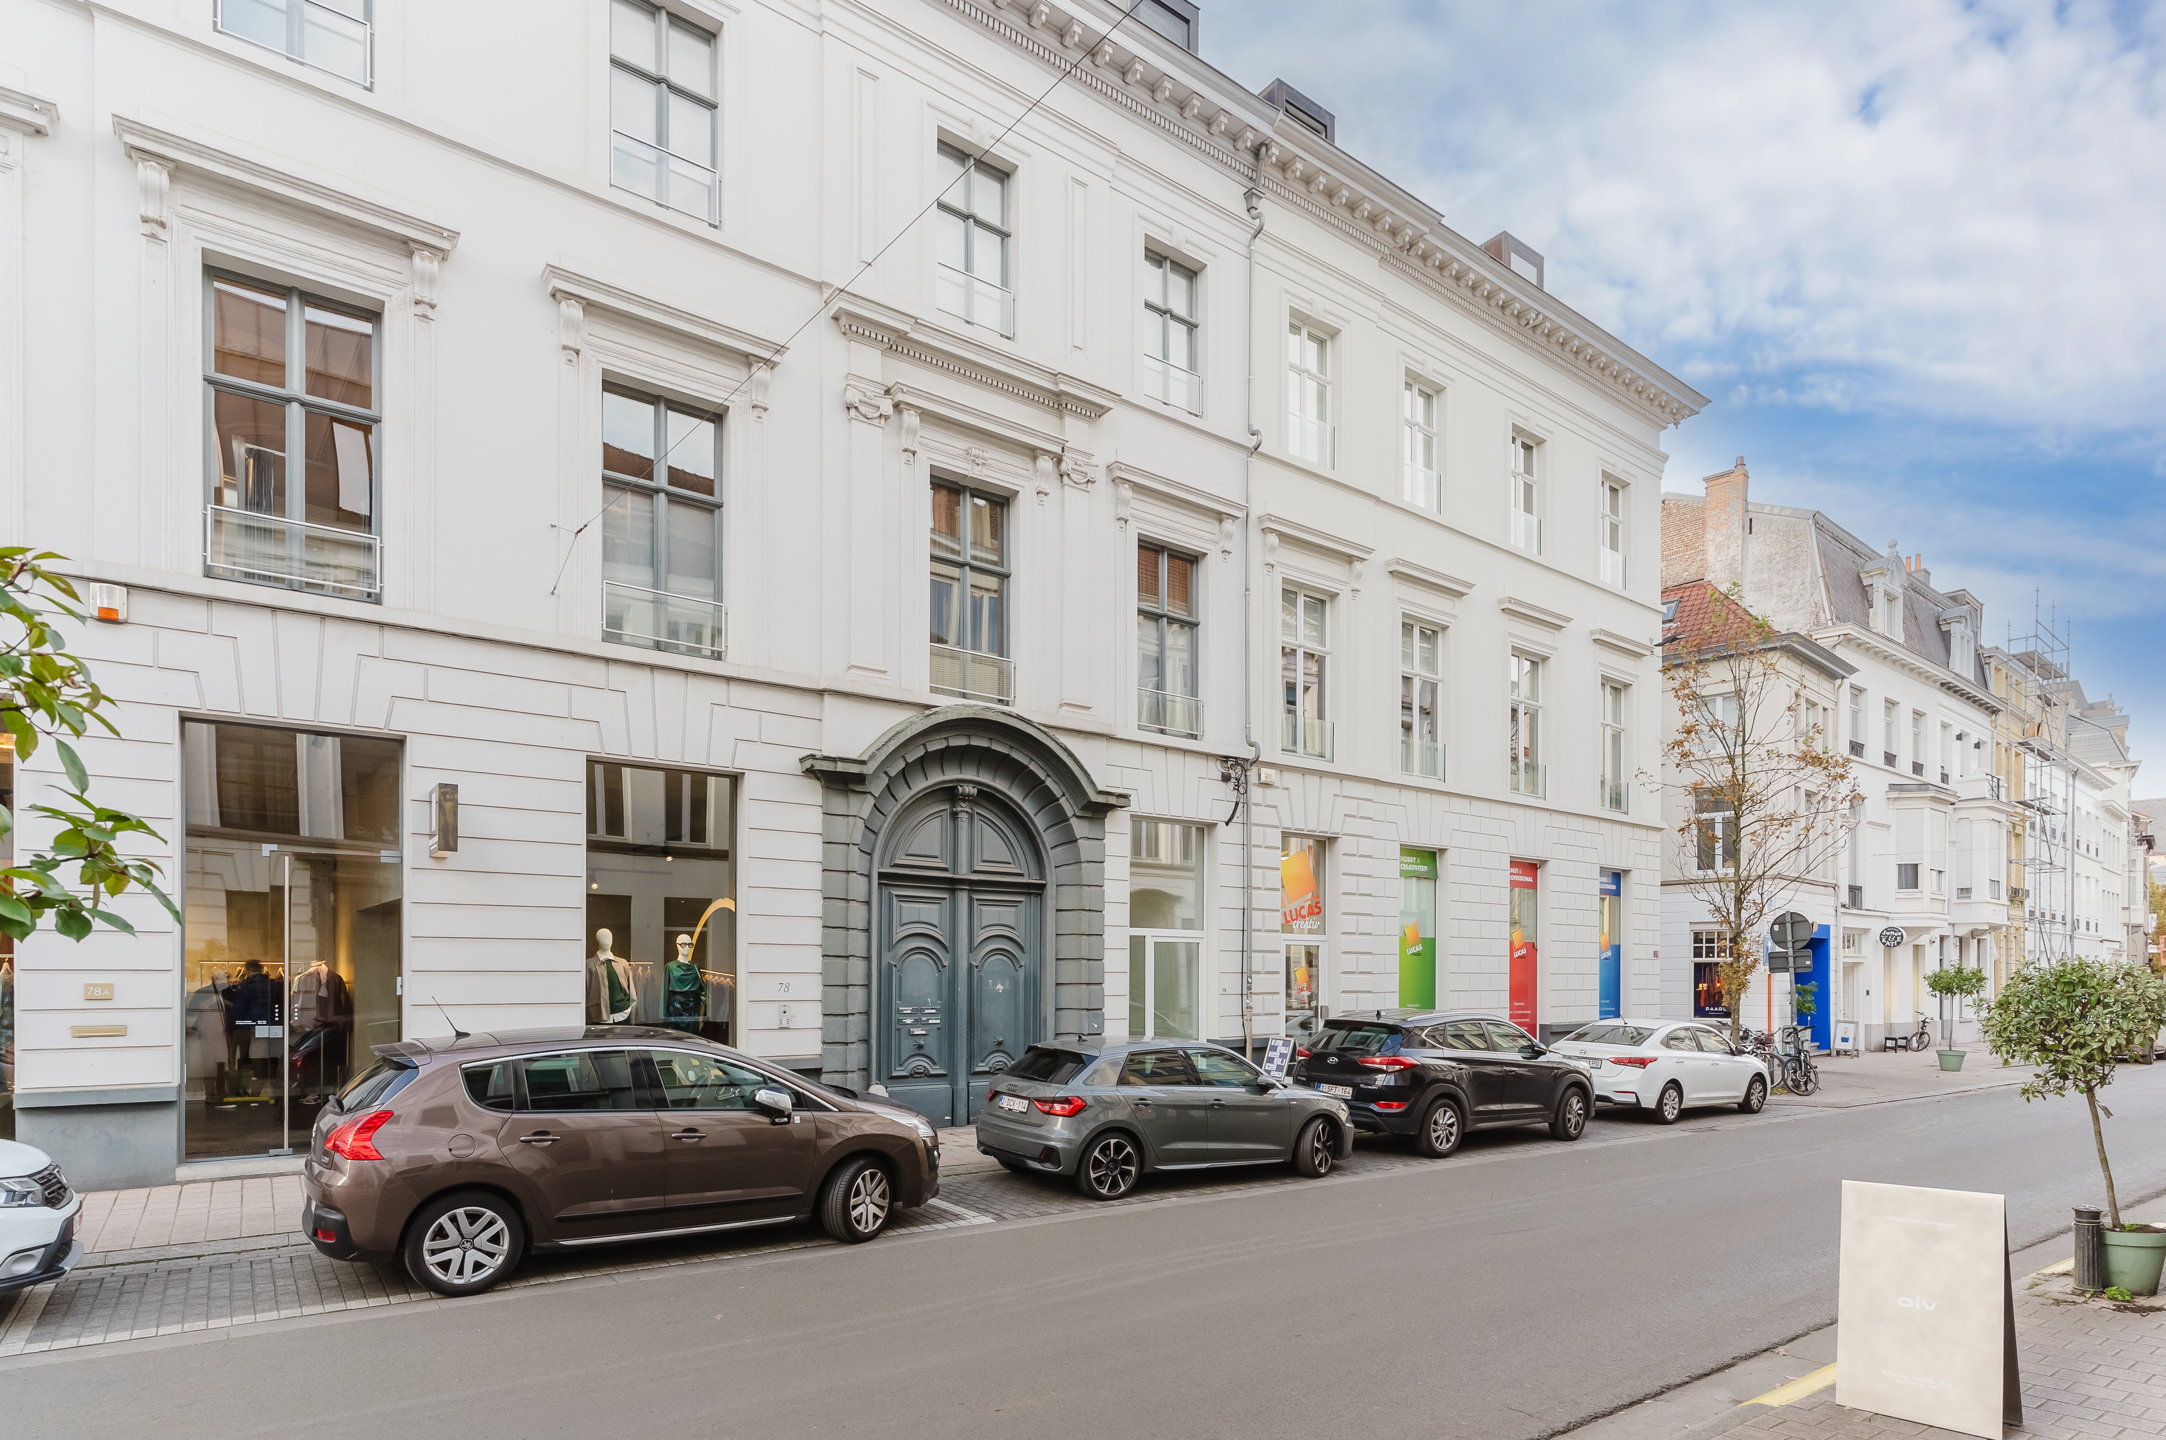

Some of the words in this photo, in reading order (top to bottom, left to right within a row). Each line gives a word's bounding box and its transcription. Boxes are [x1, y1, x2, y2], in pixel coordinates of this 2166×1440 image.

[1283, 900, 1322, 924] LUCAS
[1292, 917, 1321, 929] creativ
[1407, 944, 1422, 955] LUCAS
[1513, 948, 1527, 958] LUCAS
[778, 982, 791, 993] 78
[1897, 1296, 1938, 1311] oiv
